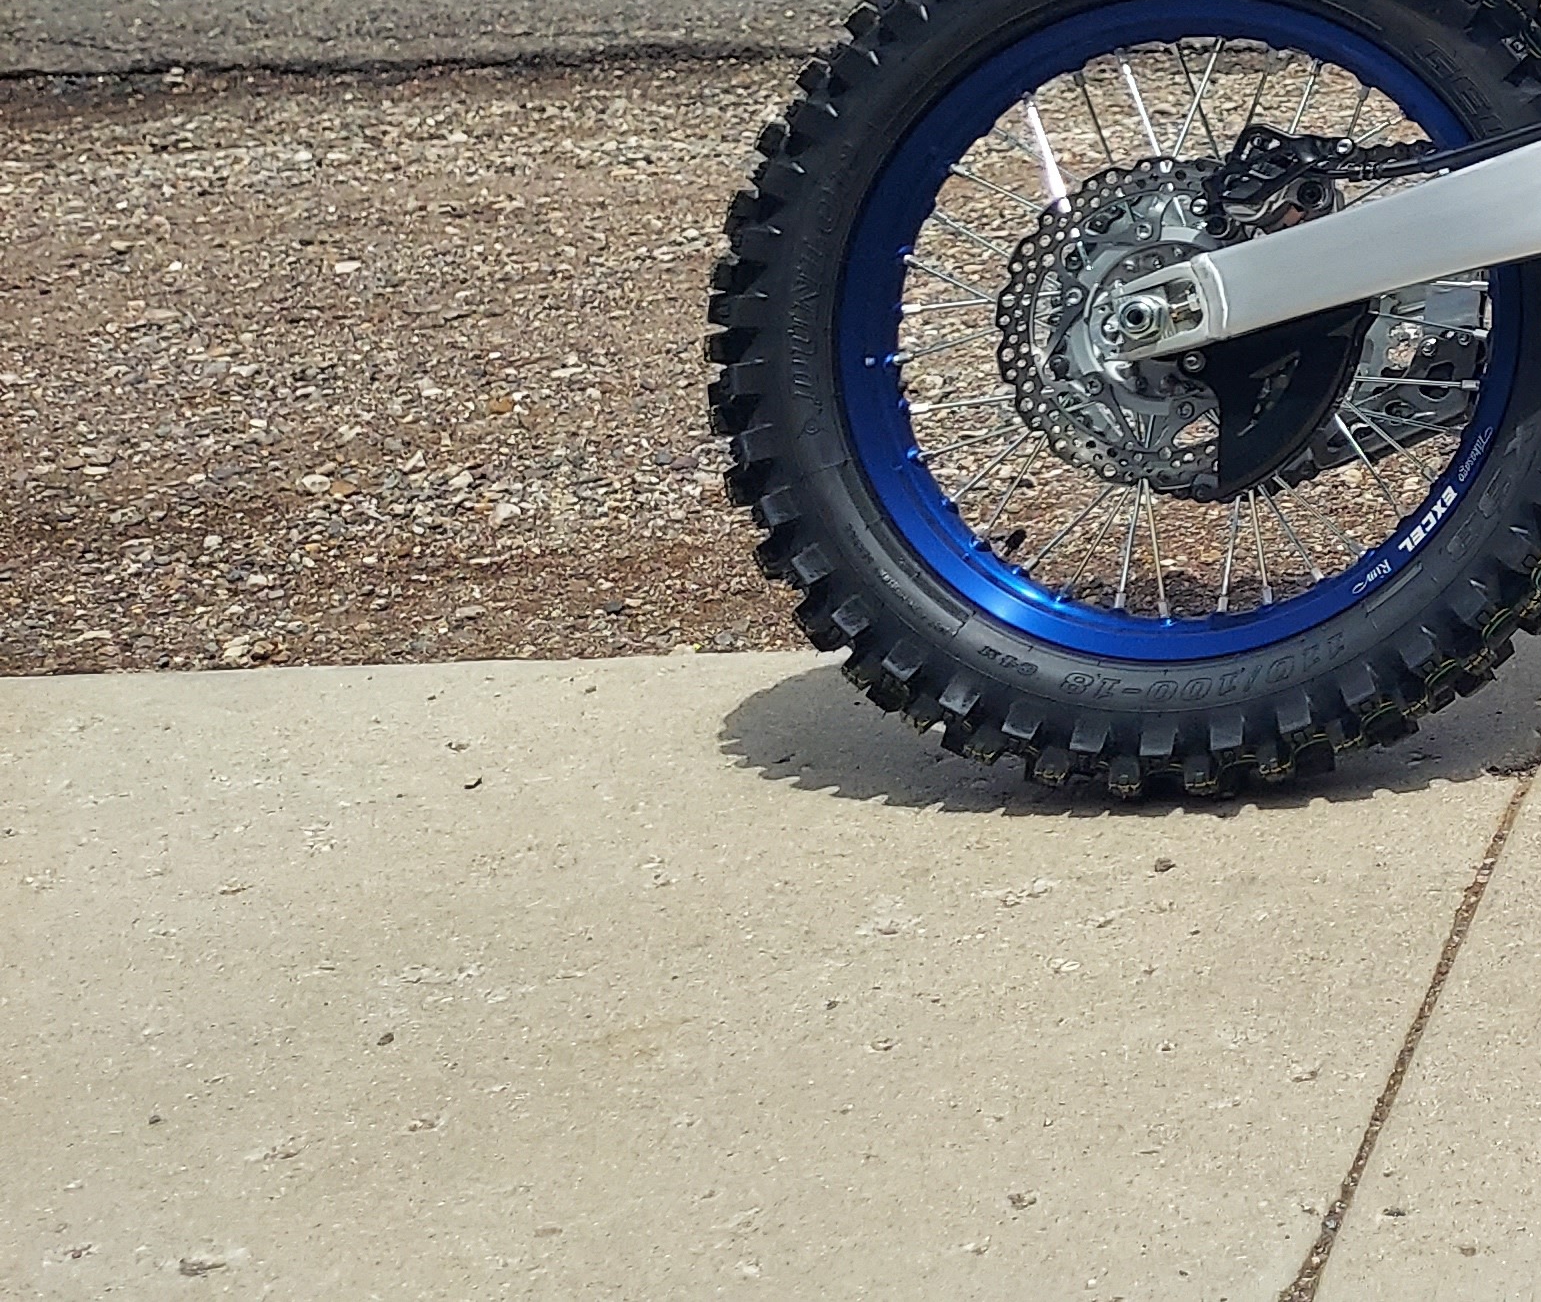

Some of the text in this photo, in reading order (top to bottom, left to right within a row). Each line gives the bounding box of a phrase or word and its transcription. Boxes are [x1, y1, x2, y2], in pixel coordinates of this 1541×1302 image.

[1398, 485, 1459, 552] EXCEL
[1352, 558, 1394, 595] Rim
[1060, 631, 1346, 701] 110/100-18
